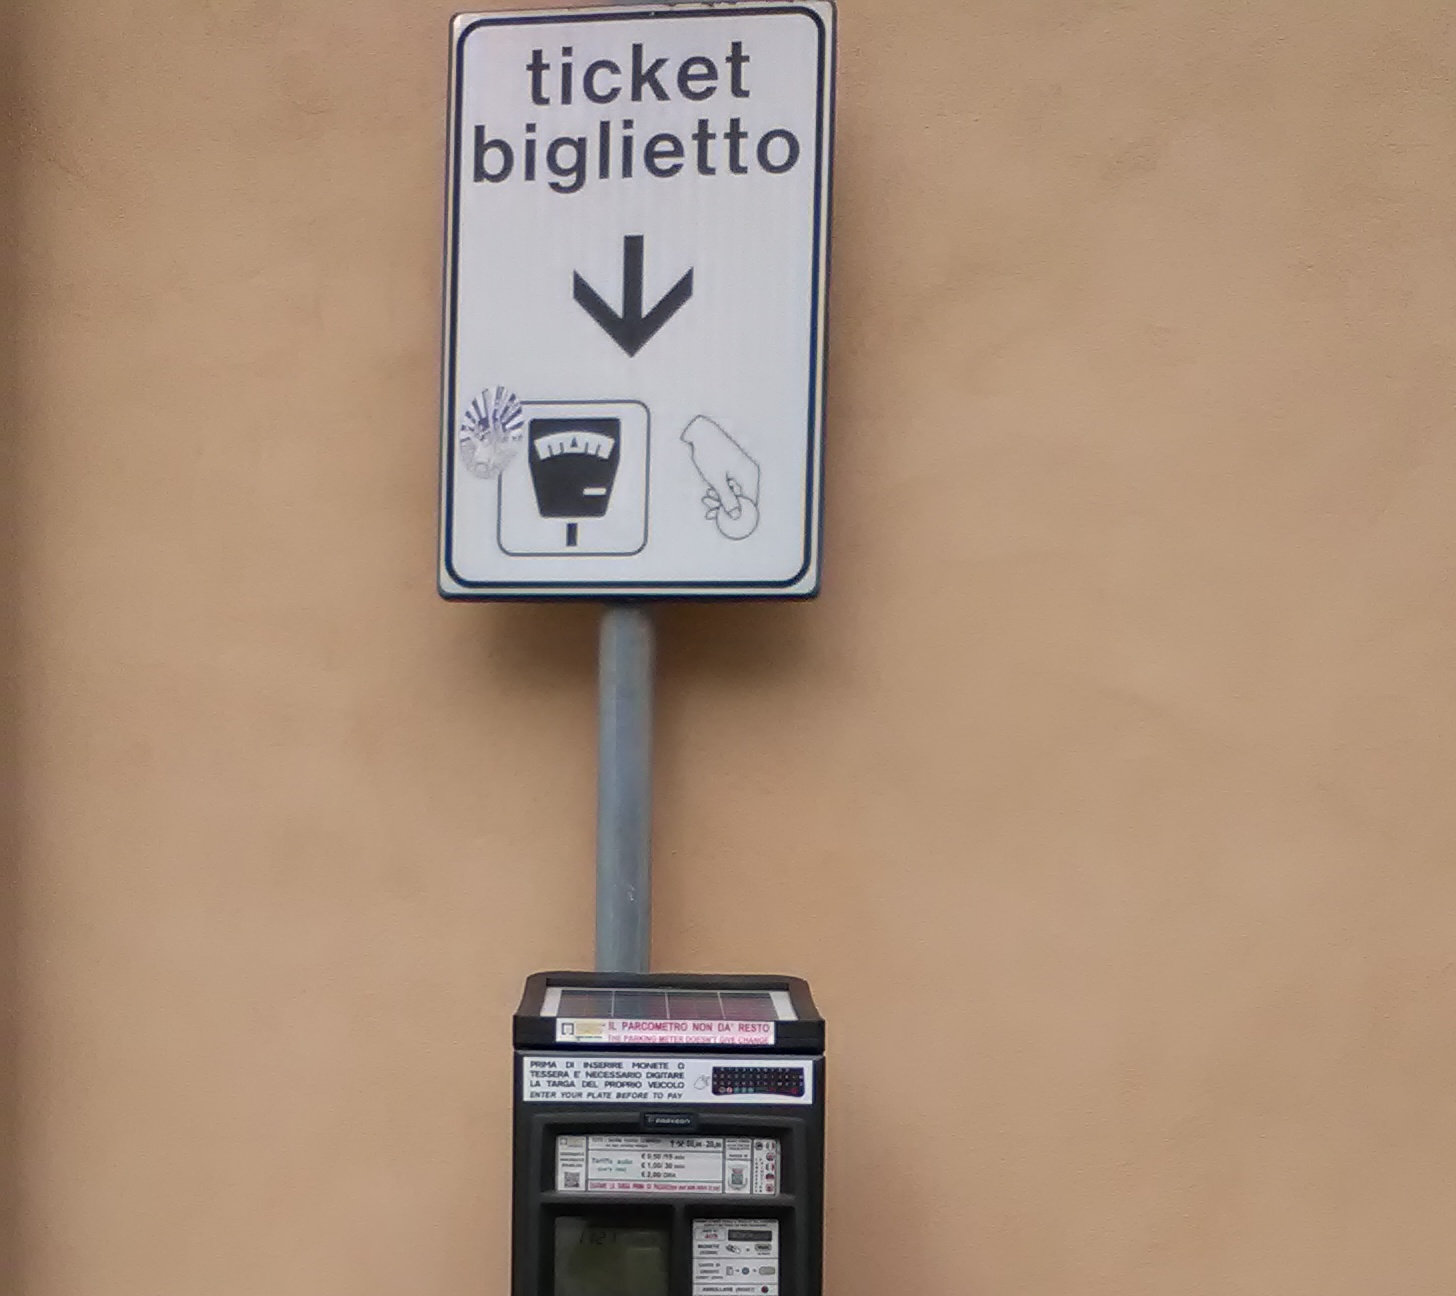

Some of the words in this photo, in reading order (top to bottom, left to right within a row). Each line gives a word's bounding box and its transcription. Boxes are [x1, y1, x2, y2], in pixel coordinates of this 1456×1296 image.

[527, 41, 750, 105] ticket
[473, 117, 800, 194] biglietto
[608, 1021, 617, 1031] IL
[621, 1021, 688, 1032] PARCOMETRO
[692, 1022, 713, 1032] NON
[738, 1023, 770, 1033] RESTO
[624, 1034, 657, 1043] PARKING
[658, 1035, 684, 1043] METER
[737, 1036, 769, 1045] CHANGE
[566, 1061, 575, 1069] DI
[583, 1061, 624, 1069] INSERIRE
[631, 1062, 669, 1070] MONETE
[530, 1070, 570, 1078] TESSERA
[585, 1071, 643, 1079] NECESSARIO
[646, 1071, 685, 1079] DIGITARE
[546, 1080, 576, 1088] TARGA
[582, 1080, 598, 1088] DEL
[604, 1081, 642, 1089] PROPRIO
[648, 1081, 685, 1089] VEICOLO
[530, 1091, 557, 1099] ENTER
[560, 1091, 583, 1099] YOUR
[586, 1091, 612, 1099] PLATE
[667, 1092, 683, 1100] PAY
